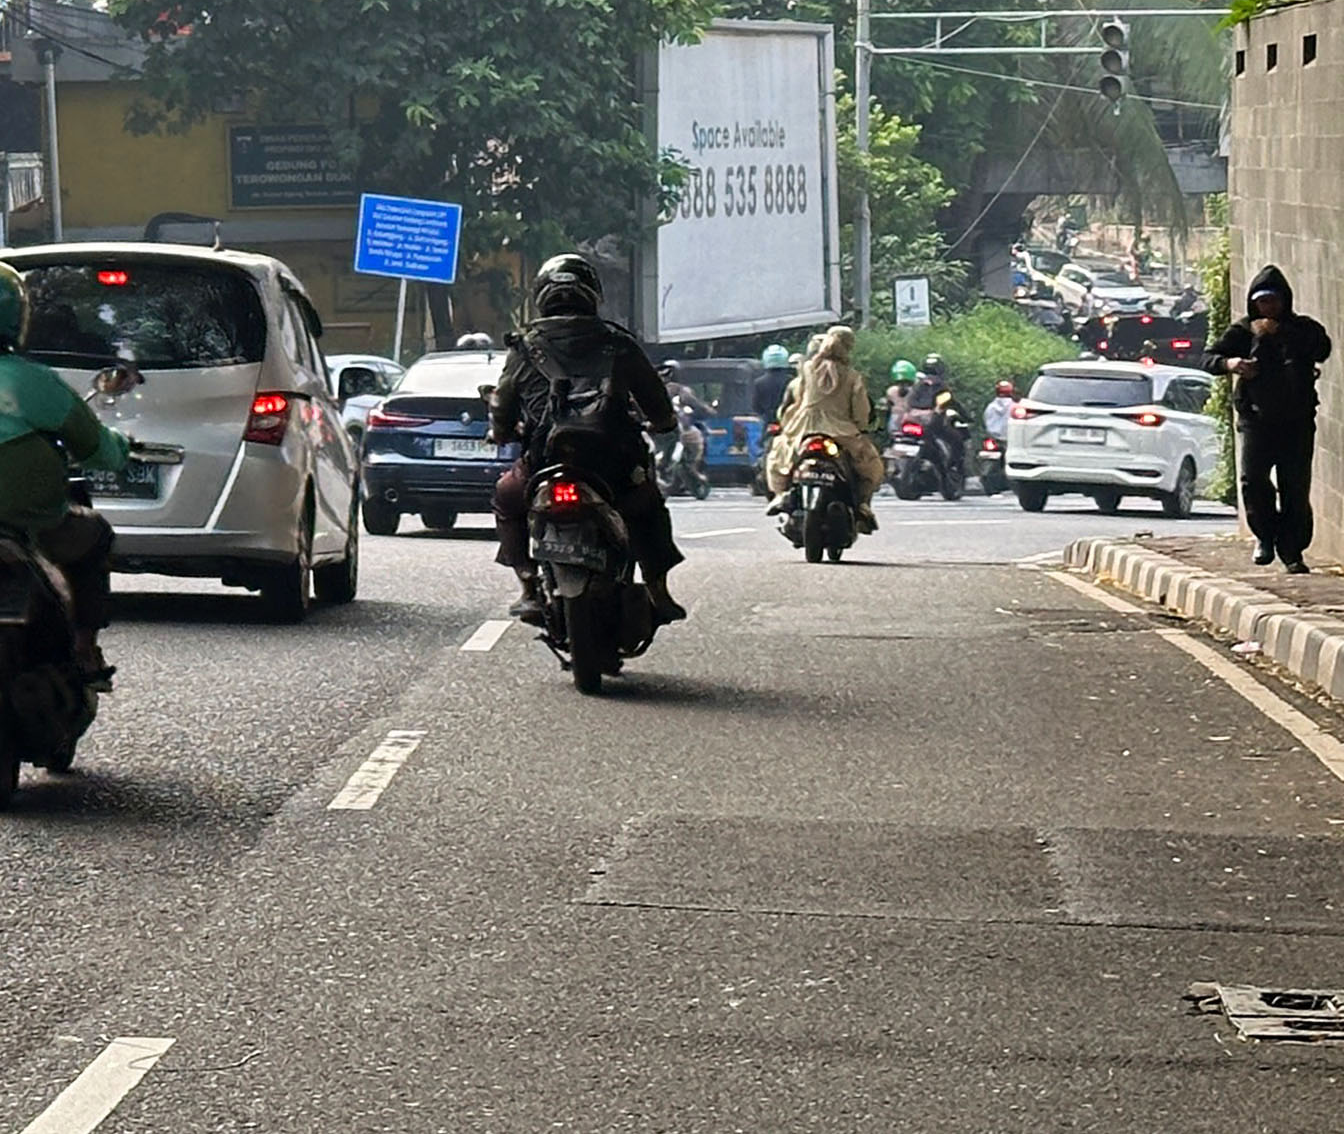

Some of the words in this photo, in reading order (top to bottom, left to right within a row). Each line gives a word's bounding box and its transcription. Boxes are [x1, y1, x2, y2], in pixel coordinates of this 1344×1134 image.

[692, 120, 729, 156] Space
[733, 120, 786, 148] Available
[723, 165, 757, 217] 535
[764, 164, 807, 214] 8888
